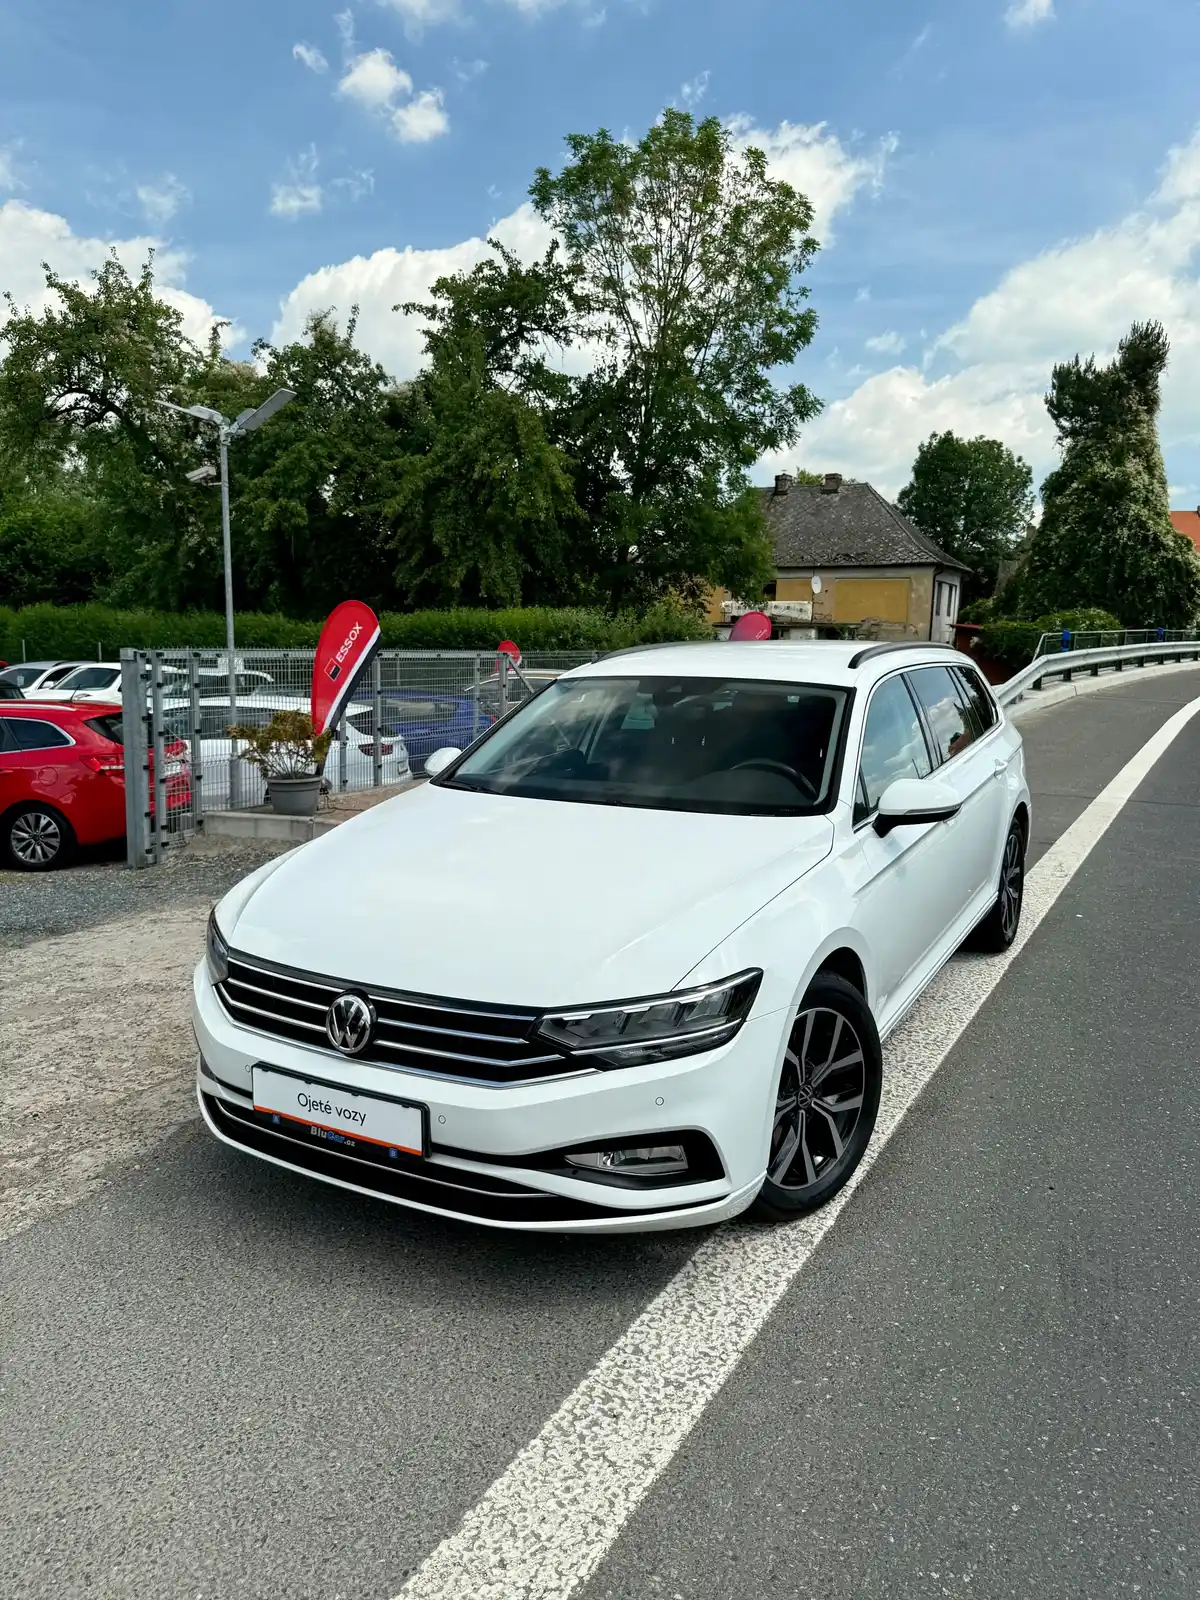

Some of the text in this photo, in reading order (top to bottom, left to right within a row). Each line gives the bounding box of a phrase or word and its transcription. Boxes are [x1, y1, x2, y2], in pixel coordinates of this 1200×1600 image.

[336, 622, 363, 663] ESSOX
[297, 1092, 366, 1126] Ojeté vozy
